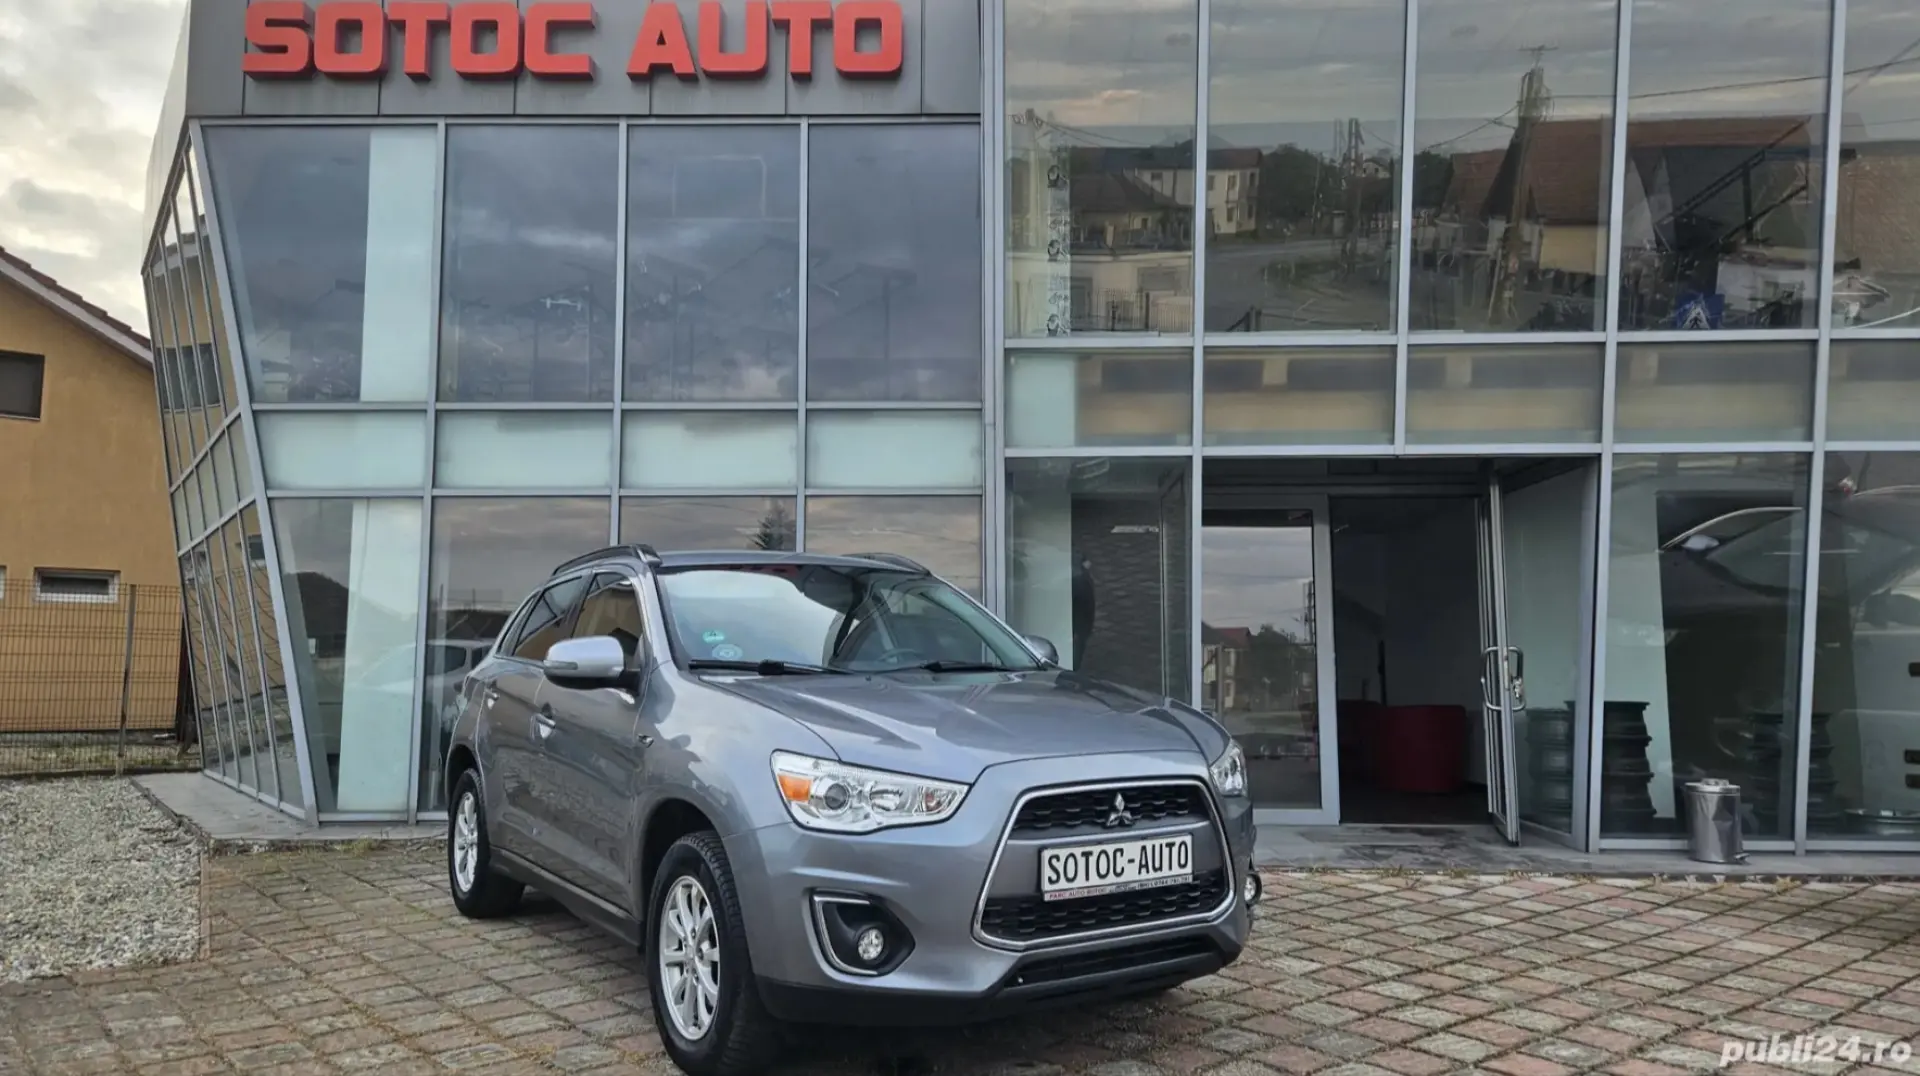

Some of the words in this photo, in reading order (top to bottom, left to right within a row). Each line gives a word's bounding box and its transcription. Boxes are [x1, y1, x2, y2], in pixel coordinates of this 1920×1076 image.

[242, 1, 597, 79] SOTOC
[626, 1, 905, 79] AUTO
[1048, 840, 1189, 885] SOTOC-AUTO
